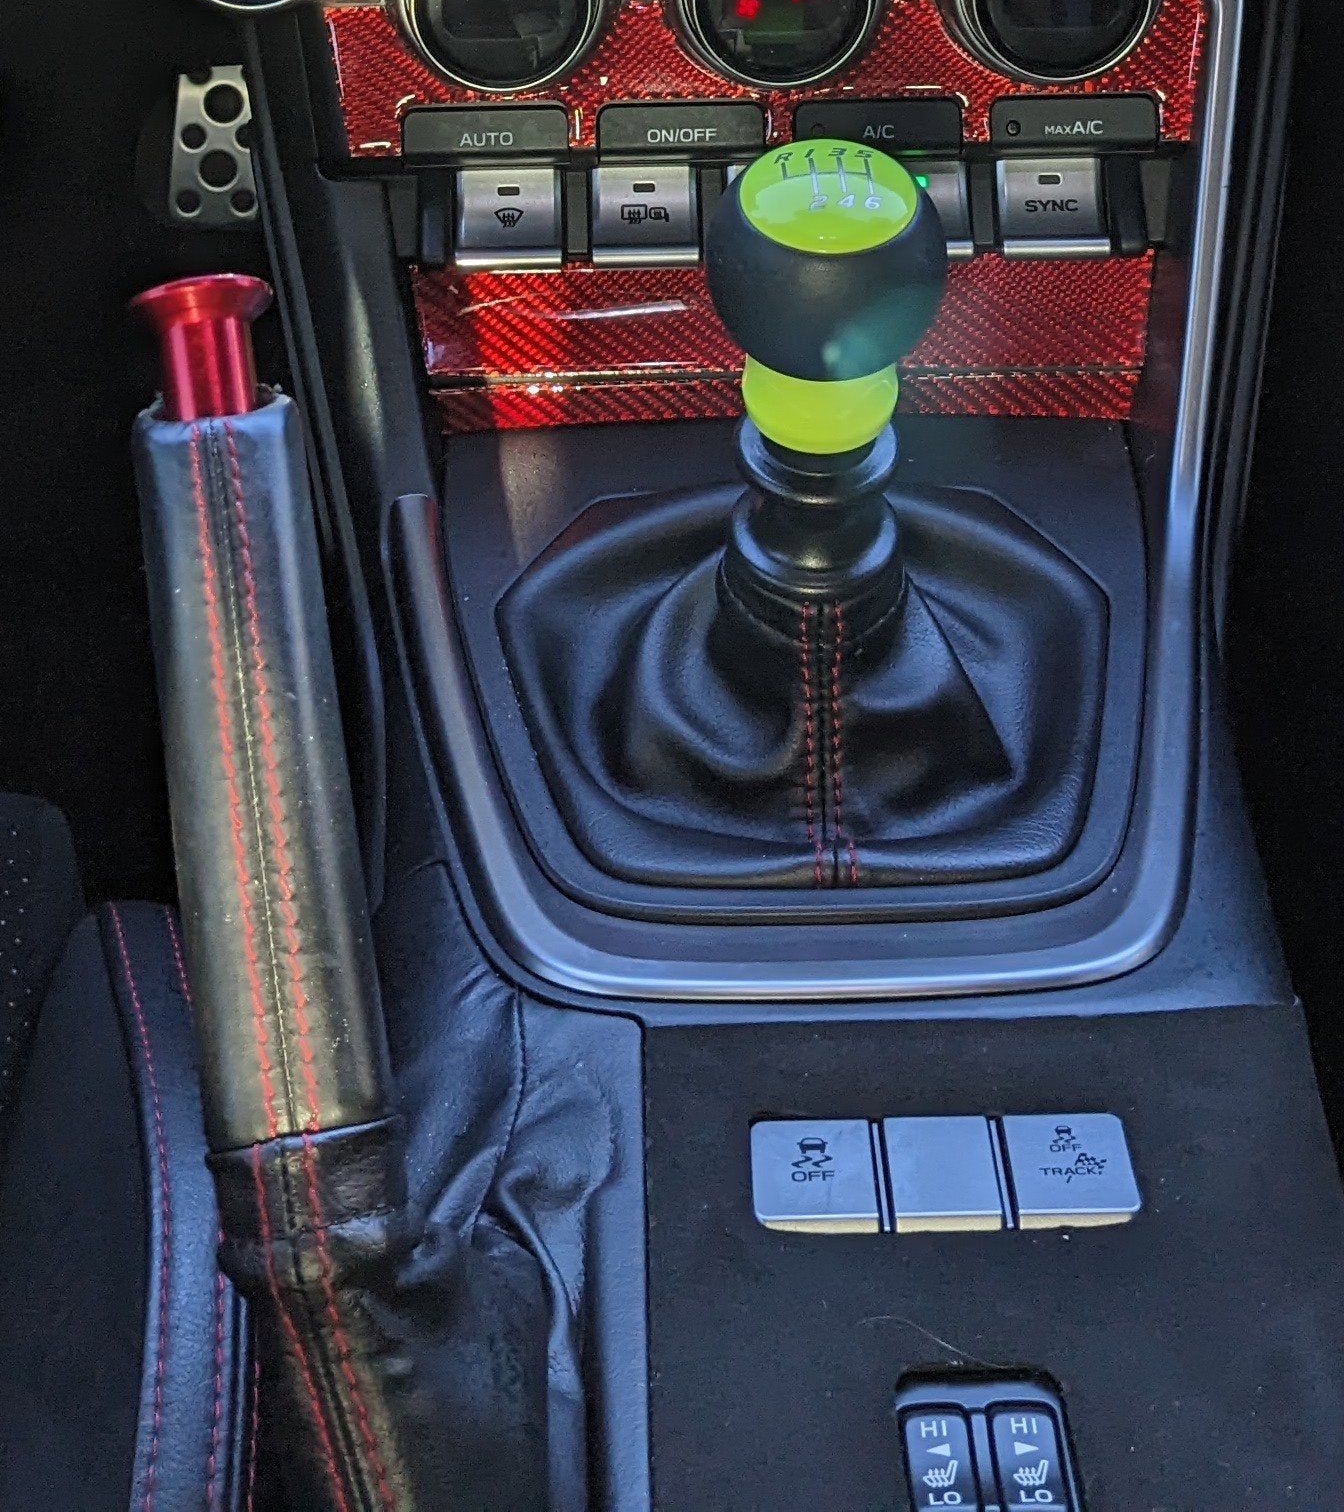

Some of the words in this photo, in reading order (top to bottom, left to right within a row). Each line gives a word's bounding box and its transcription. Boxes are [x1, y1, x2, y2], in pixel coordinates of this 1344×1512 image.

[459, 131, 514, 148] AUTO
[646, 127, 717, 144] ON/OFF
[862, 124, 895, 140] A/C
[774, 152, 794, 165] R
[804, 148, 816, 159] 1
[828, 147, 848, 158] 3
[855, 149, 874, 159] 5
[809, 195, 828, 212] 2
[837, 194, 855, 209] 4
[863, 196, 883, 210] 6
[1024, 197, 1078, 214] SYNC
[1049, 1143, 1082, 1153] OFF
[791, 1171, 835, 1183] OFF
[1038, 1167, 1097, 1176] TRACK
[920, 1419, 949, 1439] HI
[1010, 1417, 1038, 1435] HI
[928, 1491, 963, 1506] LO
[1020, 1489, 1054, 1505] LO
